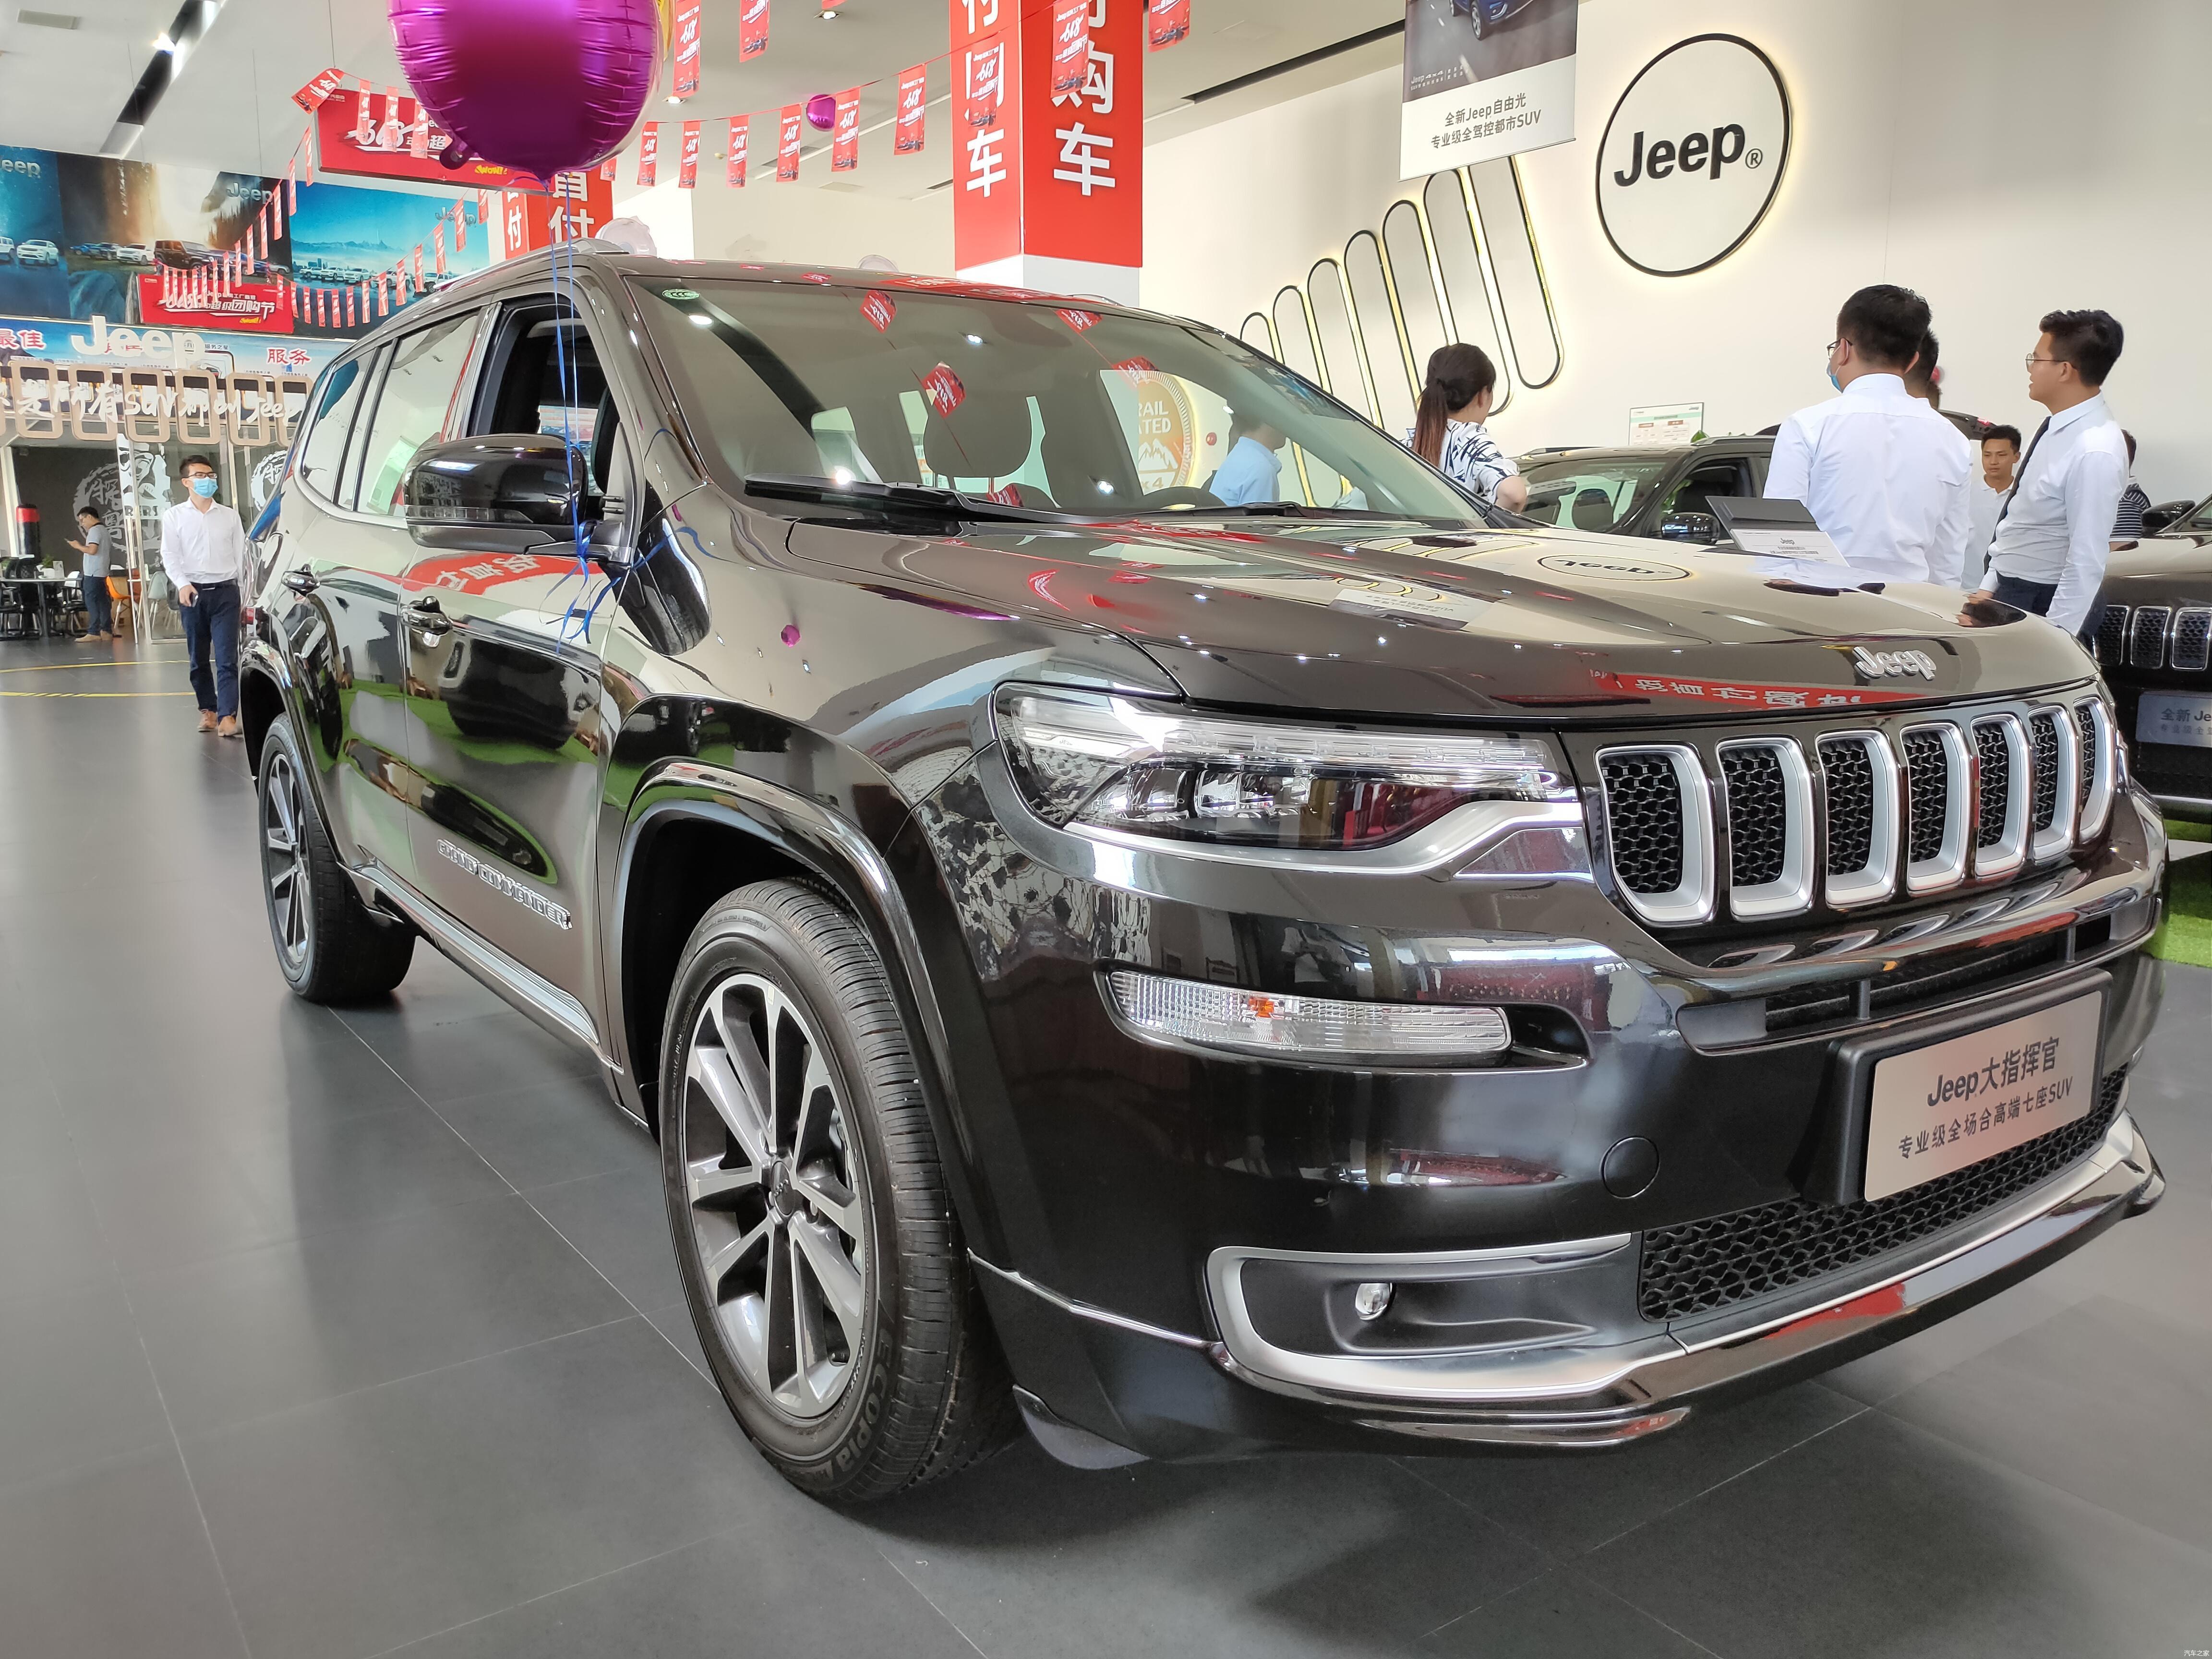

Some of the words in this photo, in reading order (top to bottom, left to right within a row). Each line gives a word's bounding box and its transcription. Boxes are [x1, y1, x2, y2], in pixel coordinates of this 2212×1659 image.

[1445, 92, 1526, 127] 全新Jeep自由光
[1431, 109, 1541, 149] 专业级全驾控都市SUV
[0, 159, 40, 177] eep
[1614, 123, 1745, 187] Jeep
[226, 182, 273, 204] Jeep
[435, 206, 477, 227] Jep
[0, 329, 45, 349] 最佳
[71, 315, 205, 369] Jeep
[267, 348, 311, 365] 服务
[1852, 646, 1937, 681] Jeep
[437, 839, 480, 876] GRAND
[478, 864, 573, 930] COMMANDER
[1927, 1035, 2059, 1106] Jeep大指挥官
[1898, 1076, 2073, 1160] 专业级全场合高端七座SUV
